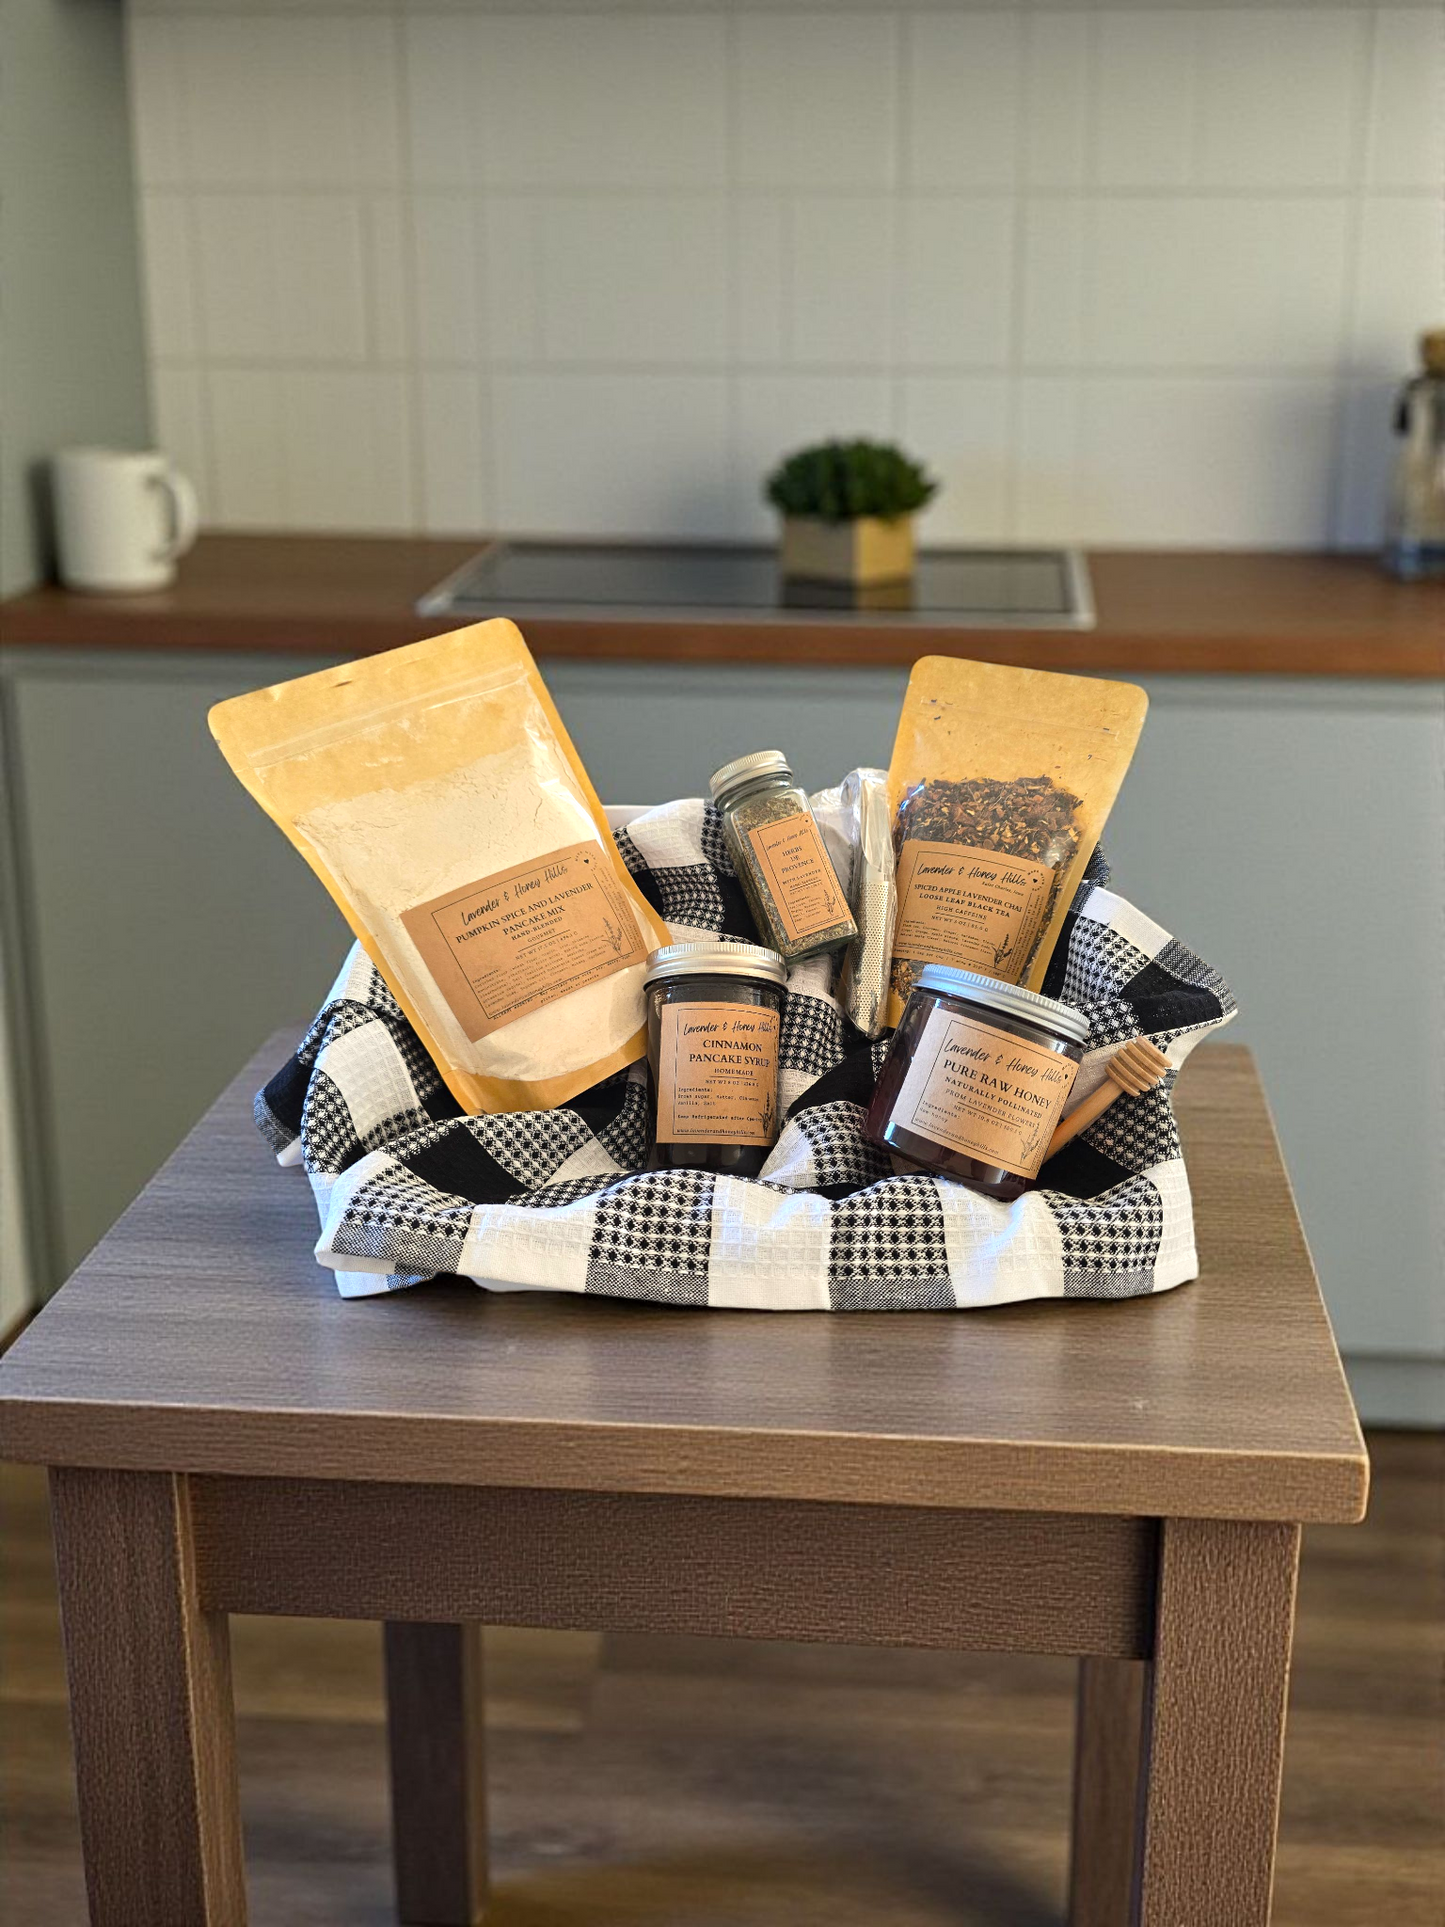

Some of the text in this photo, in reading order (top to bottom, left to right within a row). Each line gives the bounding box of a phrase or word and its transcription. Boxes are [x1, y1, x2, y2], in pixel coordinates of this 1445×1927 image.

[782, 846, 802, 856] HERBS
[782, 859, 814, 873] PROVENCE
[797, 869, 821, 879] LAVENDER
[917, 864, 1027, 886] Lavender & Honey Hills
[461, 865, 568, 926] Lavender & Honey Hills
[914, 884, 938, 892] SPICED
[939, 887, 961, 896] APPLE
[962, 891, 1002, 906] LAVENDER
[1004, 902, 1023, 913] CHAI
[456, 882, 594, 943] PUMPKIN SPICE AND LAVENDER
[919, 893, 1010, 918] LOOSE LEAF BLACK TEA
[955, 909, 987, 920] CAFFEINE
[502, 905, 566, 935] PANCAKE MIX
[527, 928, 556, 942] GOURMET
[684, 1022, 719, 1035] Lavender
[723, 1022, 728, 1031] &
[732, 1021, 755, 1033] Honey
[703, 1039, 762, 1052] CINNAMON
[689, 1053, 770, 1067] PANCAKE SYRUP
[944, 1038, 991, 1062] Lavender
[995, 1054, 1004, 1065] &
[1006, 1057, 1039, 1077] Honey
[1040, 1067, 1062, 1084] Hills
[715, 1068, 754, 1076] HOMEMADE
[944, 1059, 1052, 1109] PURE RAW HONEY
[945, 1076, 1043, 1119] NATURALLY POLLINATED
[946, 1088, 967, 1100] FROM
[969, 1098, 1006, 1116] LAVENDER
[922, 1100, 961, 1119] Ingredients:
[953, 1104, 965, 1113] NET
